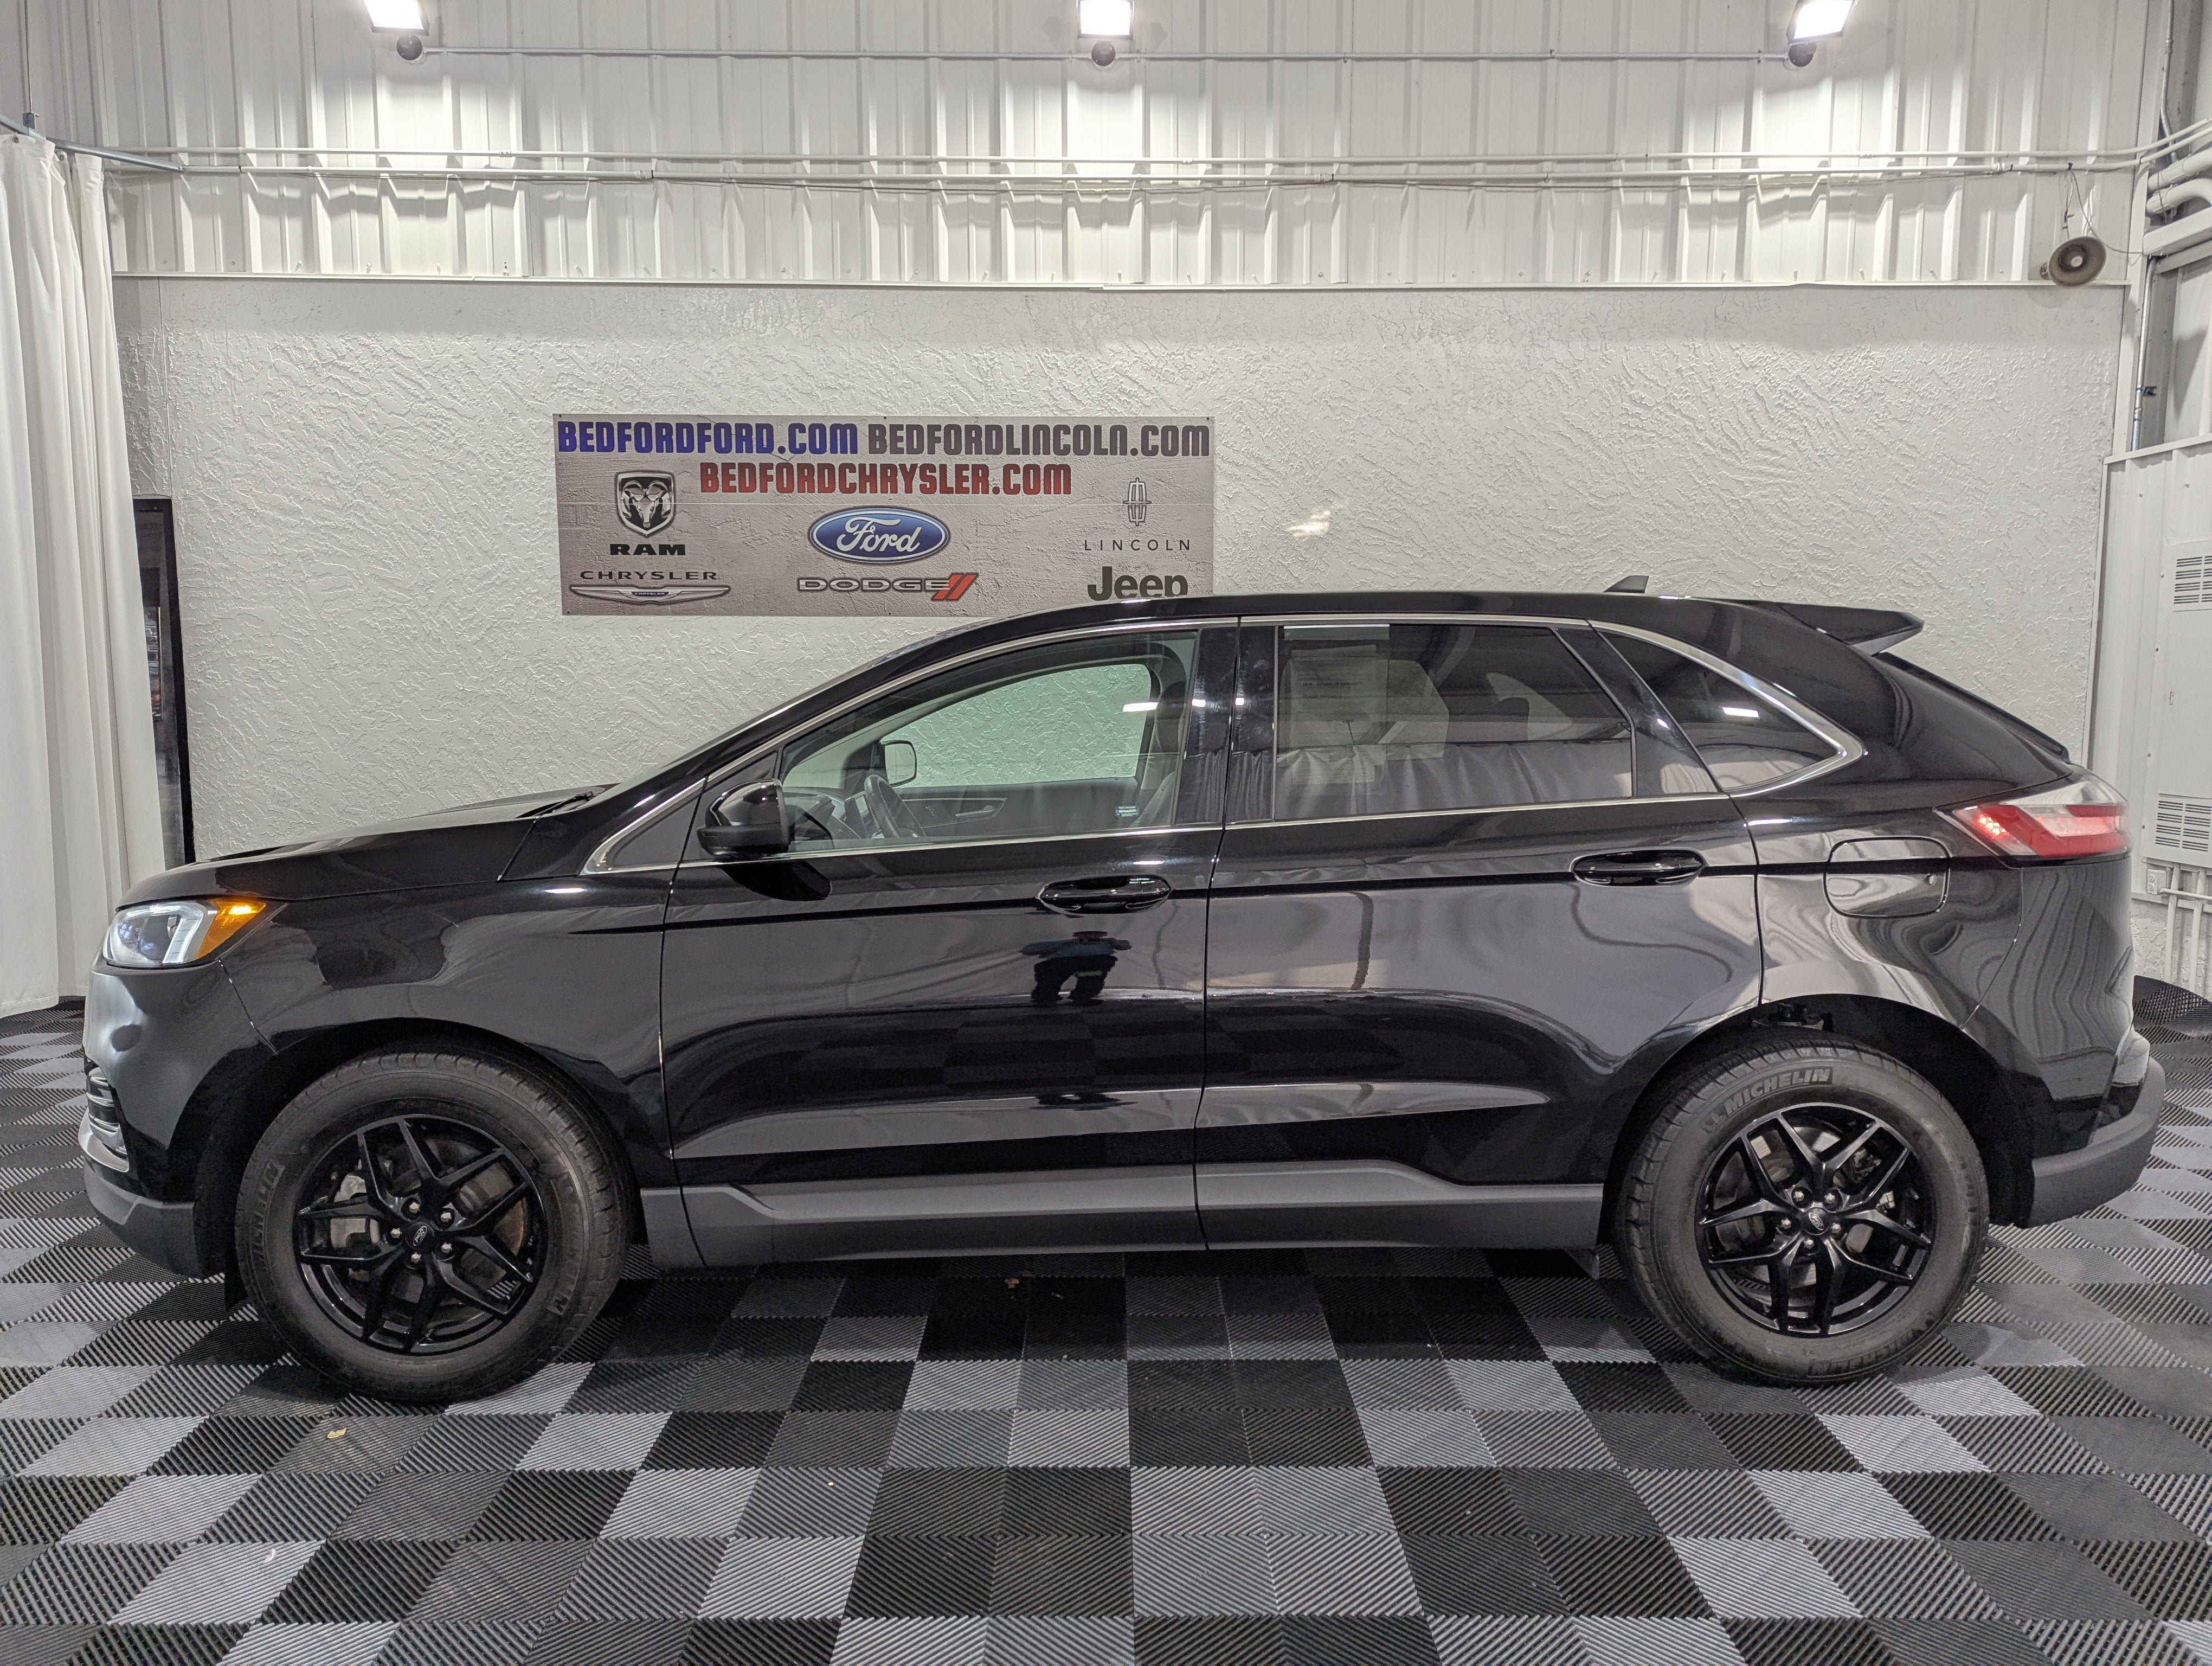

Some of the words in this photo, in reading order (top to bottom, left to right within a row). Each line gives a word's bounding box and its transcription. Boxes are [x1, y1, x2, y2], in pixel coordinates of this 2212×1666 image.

[557, 421, 858, 454] BEDFORDFORD.COM
[868, 424, 1210, 457] BEDFORDLINCOLN.COM
[699, 462, 1072, 495] BEDFORDCHRYSLER.COM
[610, 543, 686, 556] RAM
[837, 517, 922, 552] Ford
[1084, 539, 1191, 551] LINCOLN
[580, 570, 718, 580] CHRYSLER
[798, 578, 950, 591] DODGE
[1087, 566, 1188, 601] Jeep
[1724, 1068, 1831, 1116] MICHELIN
